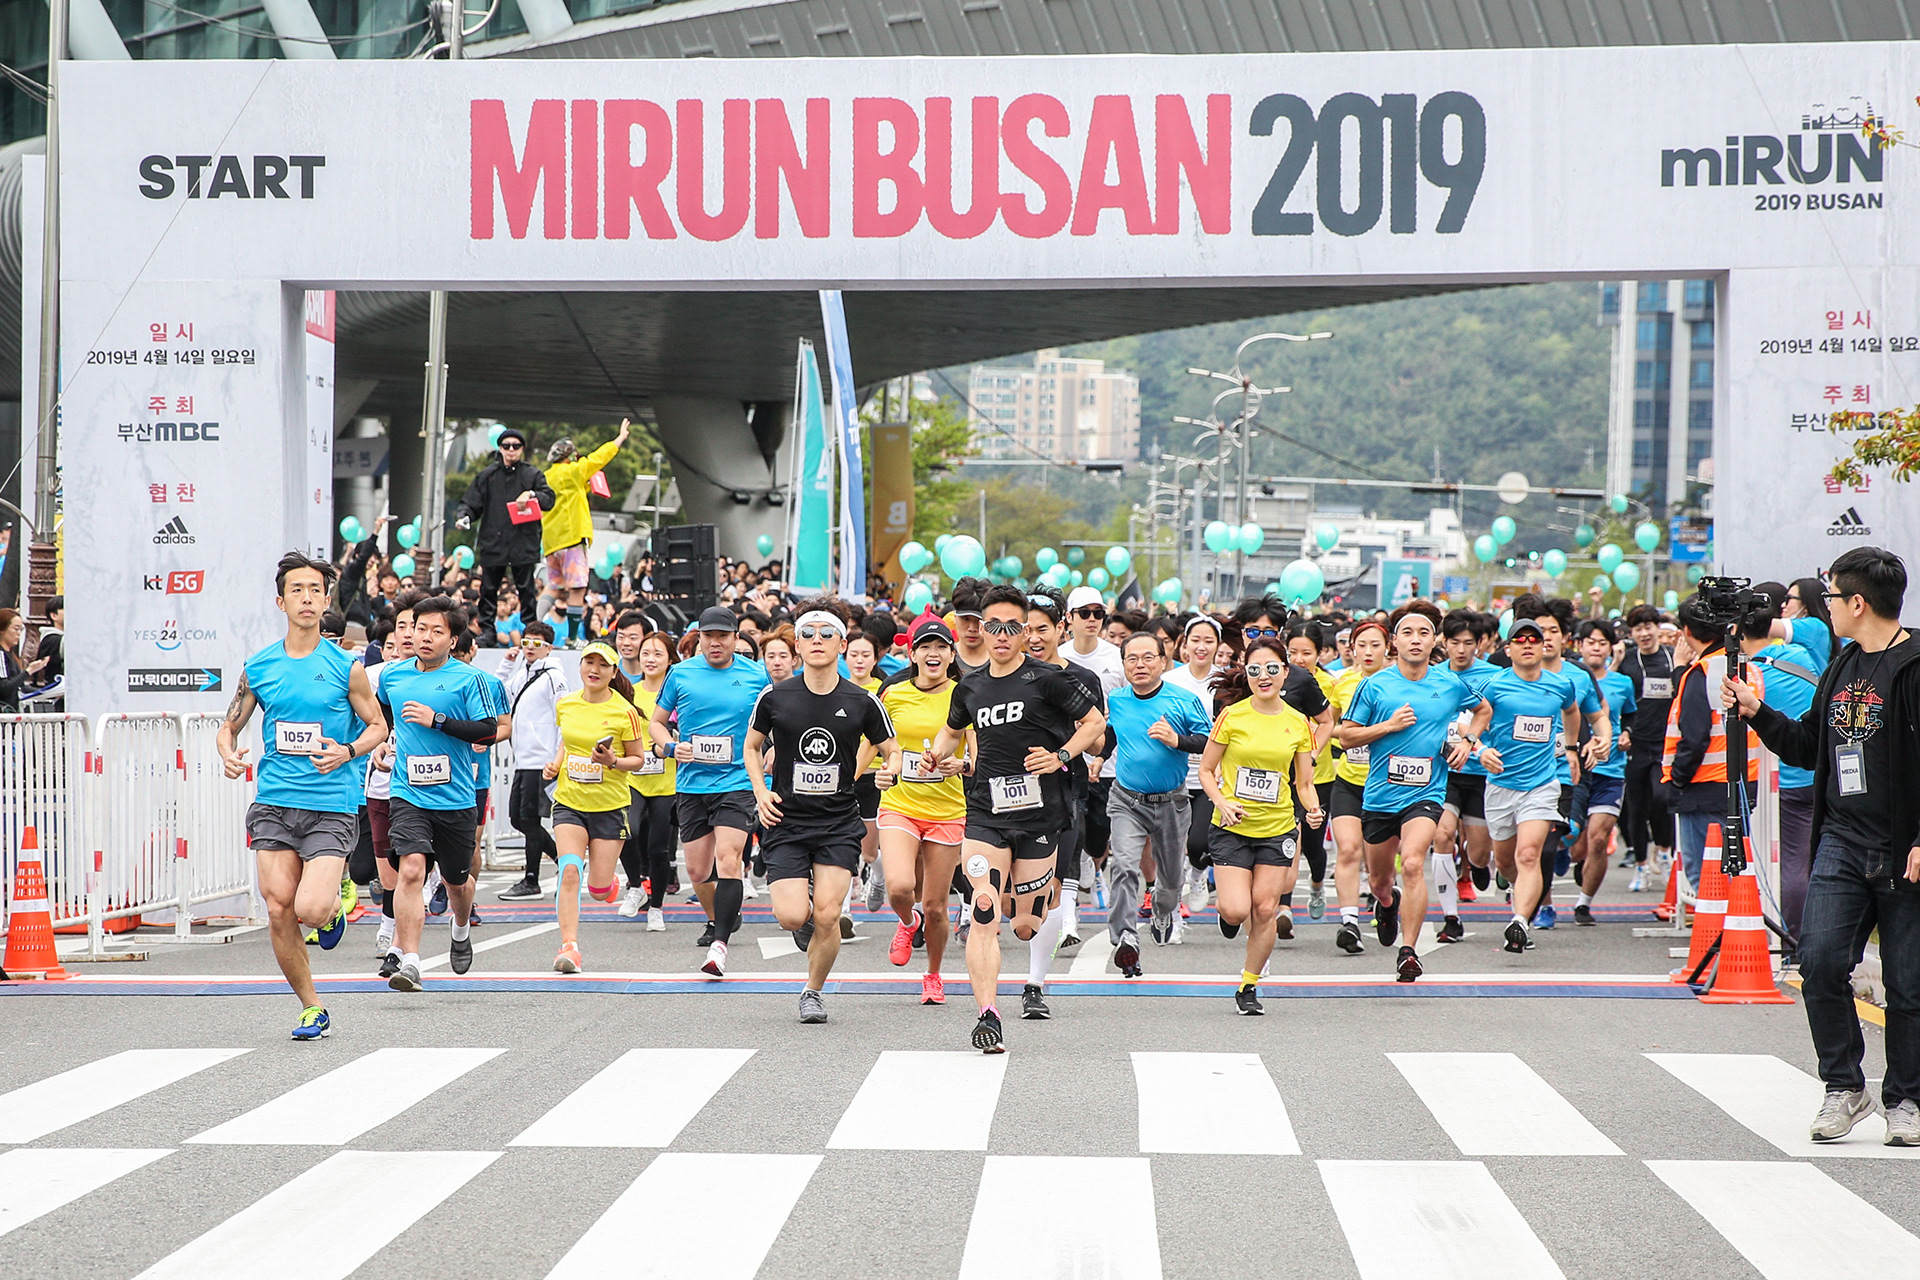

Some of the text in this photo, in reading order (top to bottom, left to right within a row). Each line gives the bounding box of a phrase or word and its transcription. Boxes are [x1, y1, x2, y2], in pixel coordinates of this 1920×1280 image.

[470, 91, 1487, 241] MIRUN BUSAN 2019
[1661, 132, 1883, 187] miRUN
[138, 155, 326, 199] START
[1755, 193, 1883, 211] 2019 BUSAN
[1760, 336, 1920, 354] 2019년 4월 14일 일요
[87, 349, 256, 365] 2019년 4월 14일 일요일
[1826, 523, 1872, 536] adidas
[152, 533, 196, 545] adidas
[143, 574, 198, 591] kt 5G
[128, 673, 210, 687] 파워에이드
[976, 701, 1025, 729] RCB
[1523, 722, 1544, 733] 1001
[283, 731, 313, 743] 1057
[700, 743, 723, 753] 1017
[413, 763, 442, 775] 1034
[568, 761, 601, 774] 50059
[1396, 764, 1425, 776] 1020
[801, 772, 832, 784] 1002
[1245, 776, 1272, 790] 1507
[1002, 785, 1029, 799] 1011
